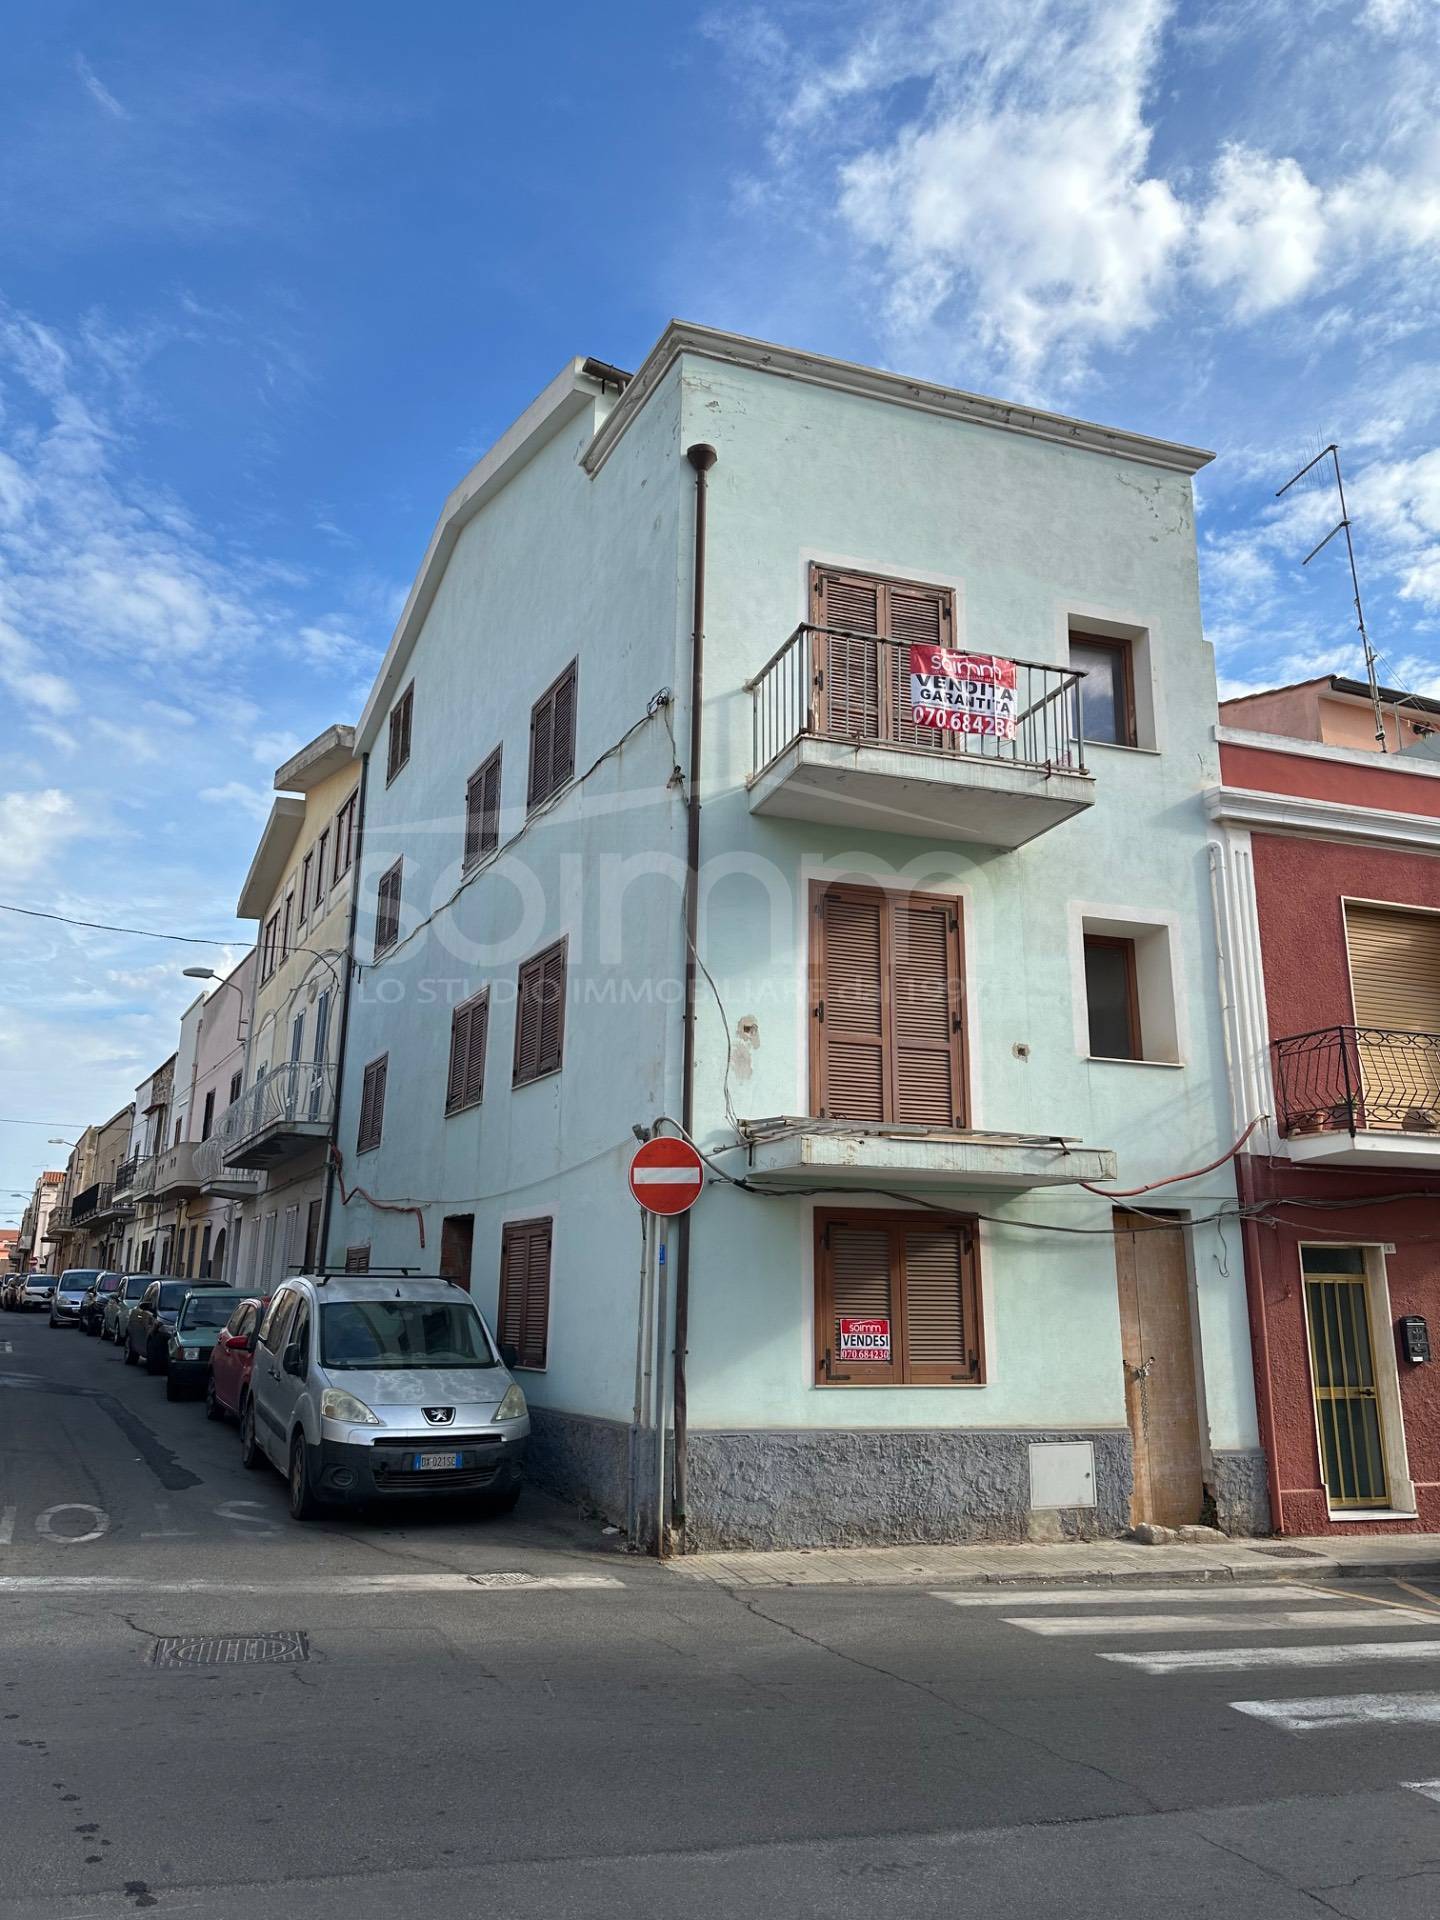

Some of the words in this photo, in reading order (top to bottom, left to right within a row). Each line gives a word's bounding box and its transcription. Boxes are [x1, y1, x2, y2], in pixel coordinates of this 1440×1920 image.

[916, 674, 1013, 701] VENDITA
[920, 688, 1011, 714] GARANTITA
[849, 1324, 882, 1332] soimm
[842, 1334, 889, 1347] VENDESI
[842, 1350, 889, 1359] 070.684230
